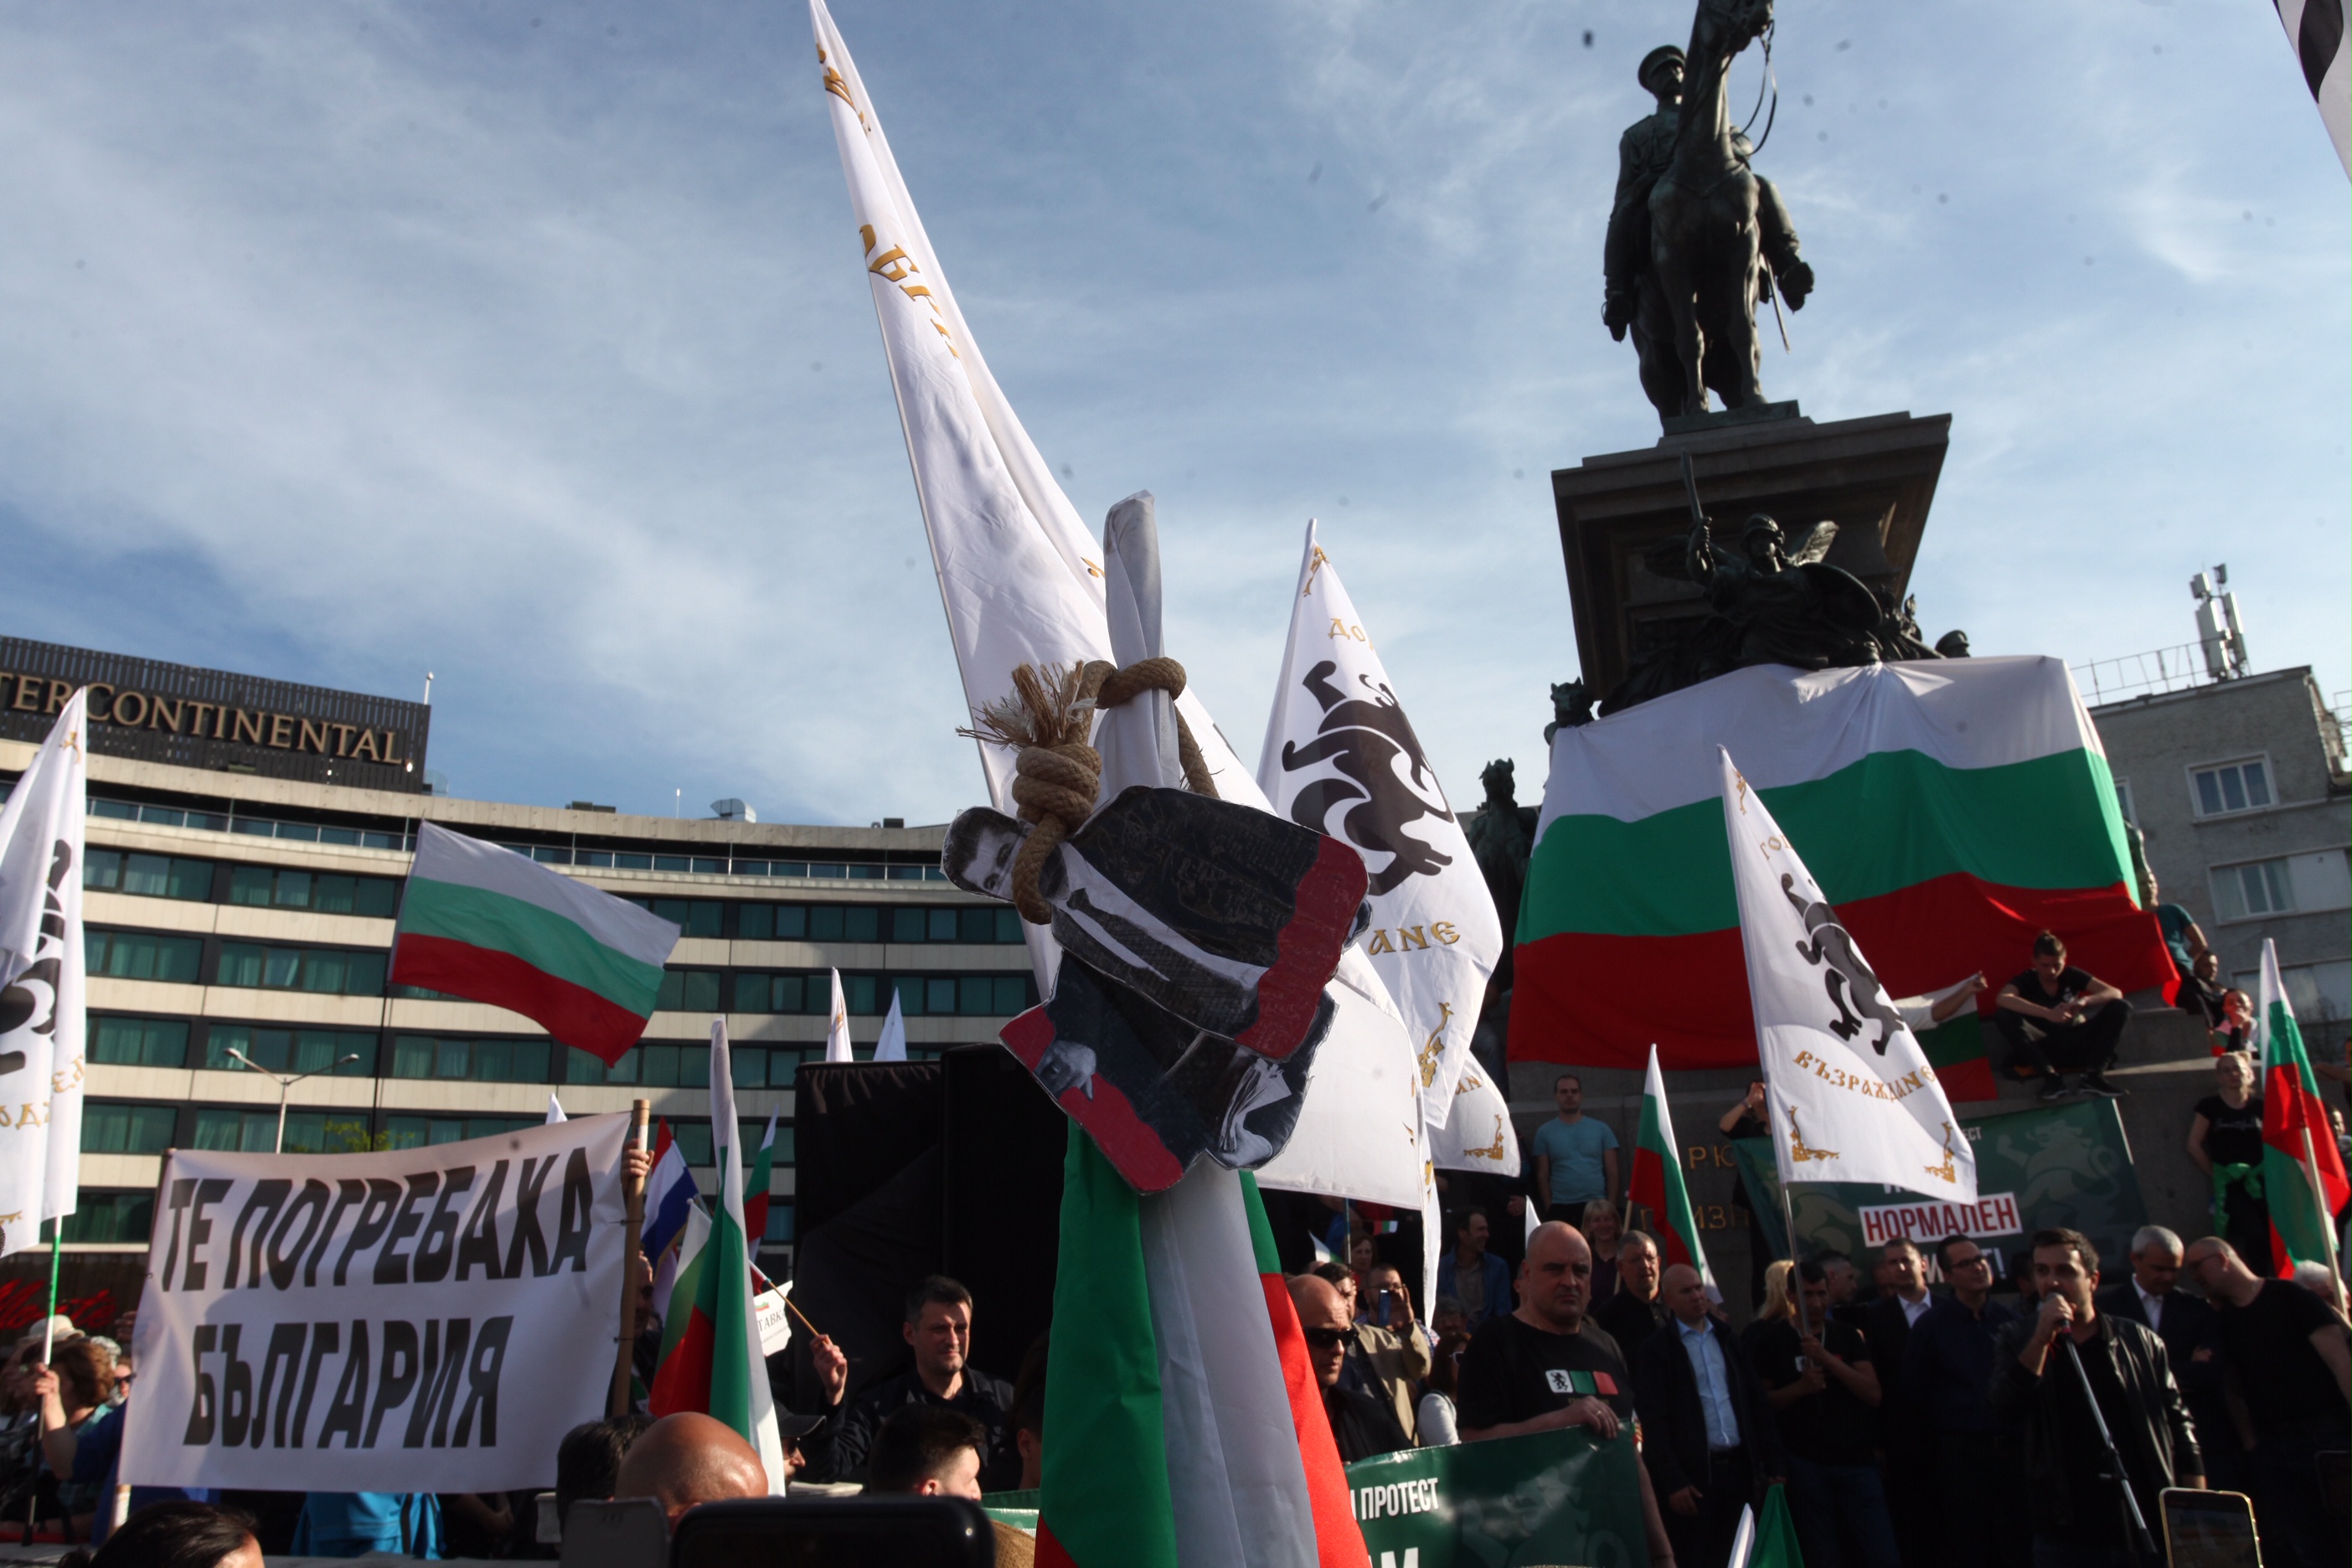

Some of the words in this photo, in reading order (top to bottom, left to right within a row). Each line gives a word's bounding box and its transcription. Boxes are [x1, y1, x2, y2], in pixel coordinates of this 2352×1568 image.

[162, 1179, 235, 1292] ТЕ
[223, 1147, 593, 1291] ПОГРЕБАХА
[1864, 1197, 2017, 1242] НОРМАЛЕН
[183, 1316, 513, 1449] БЪЛГАРИЯ
[1360, 1477, 1439, 1520] ПРОТЕСТ
